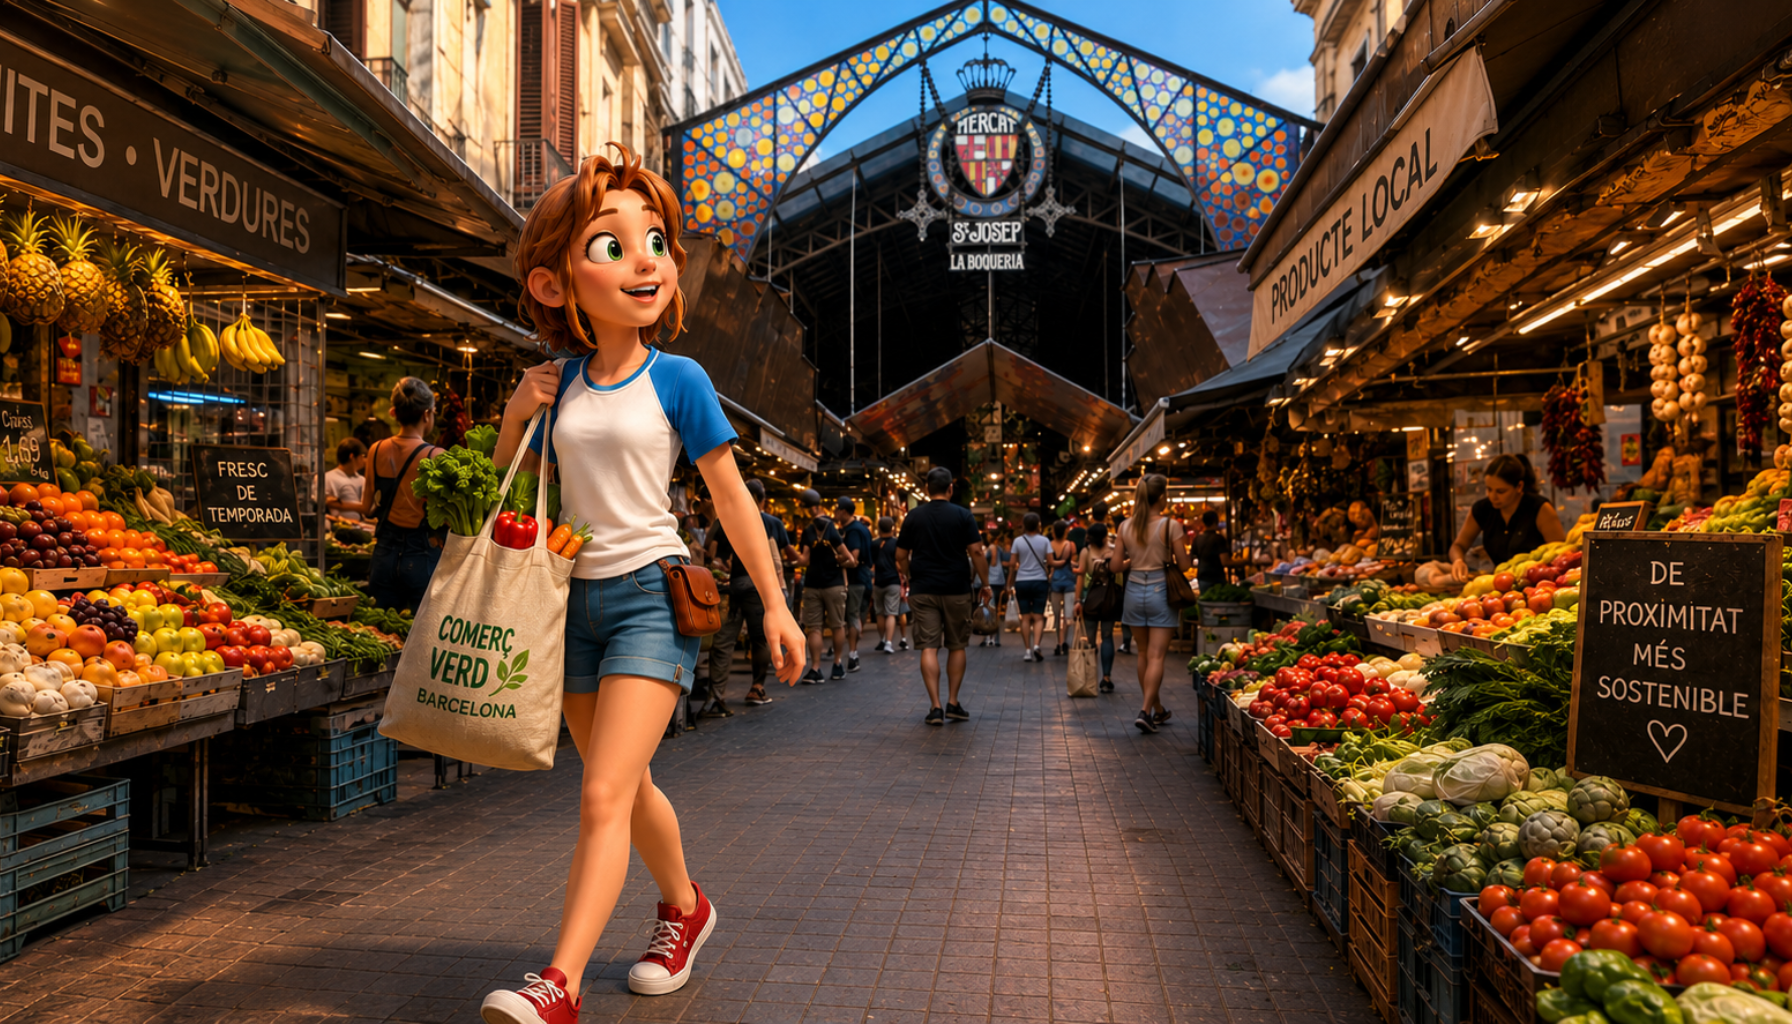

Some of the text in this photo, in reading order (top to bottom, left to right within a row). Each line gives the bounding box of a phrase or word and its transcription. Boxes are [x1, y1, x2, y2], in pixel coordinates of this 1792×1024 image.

[957, 112, 1017, 134] MERCAT
[0, 64, 105, 168] ITES
[153, 137, 310, 254] VERDURES
[969, 221, 1022, 243] JOSEP
[1271, 127, 1438, 325] PRODUCTE LOCAL
[950, 254, 1025, 270] LA BOQUERIA
[217, 461, 269, 478] FRESC
[236, 485, 258, 501] DE
[207, 506, 294, 524] TEMPORADA
[1650, 561, 1685, 586] DE
[1599, 599, 1744, 634] PROXIMITAT
[438, 614, 515, 659] COMERÇ
[430, 646, 490, 689] VERD
[1633, 638, 1686, 671] MÉS
[416, 687, 517, 719] BARCELONA
[1597, 675, 1750, 719] SOSTENIBLE
